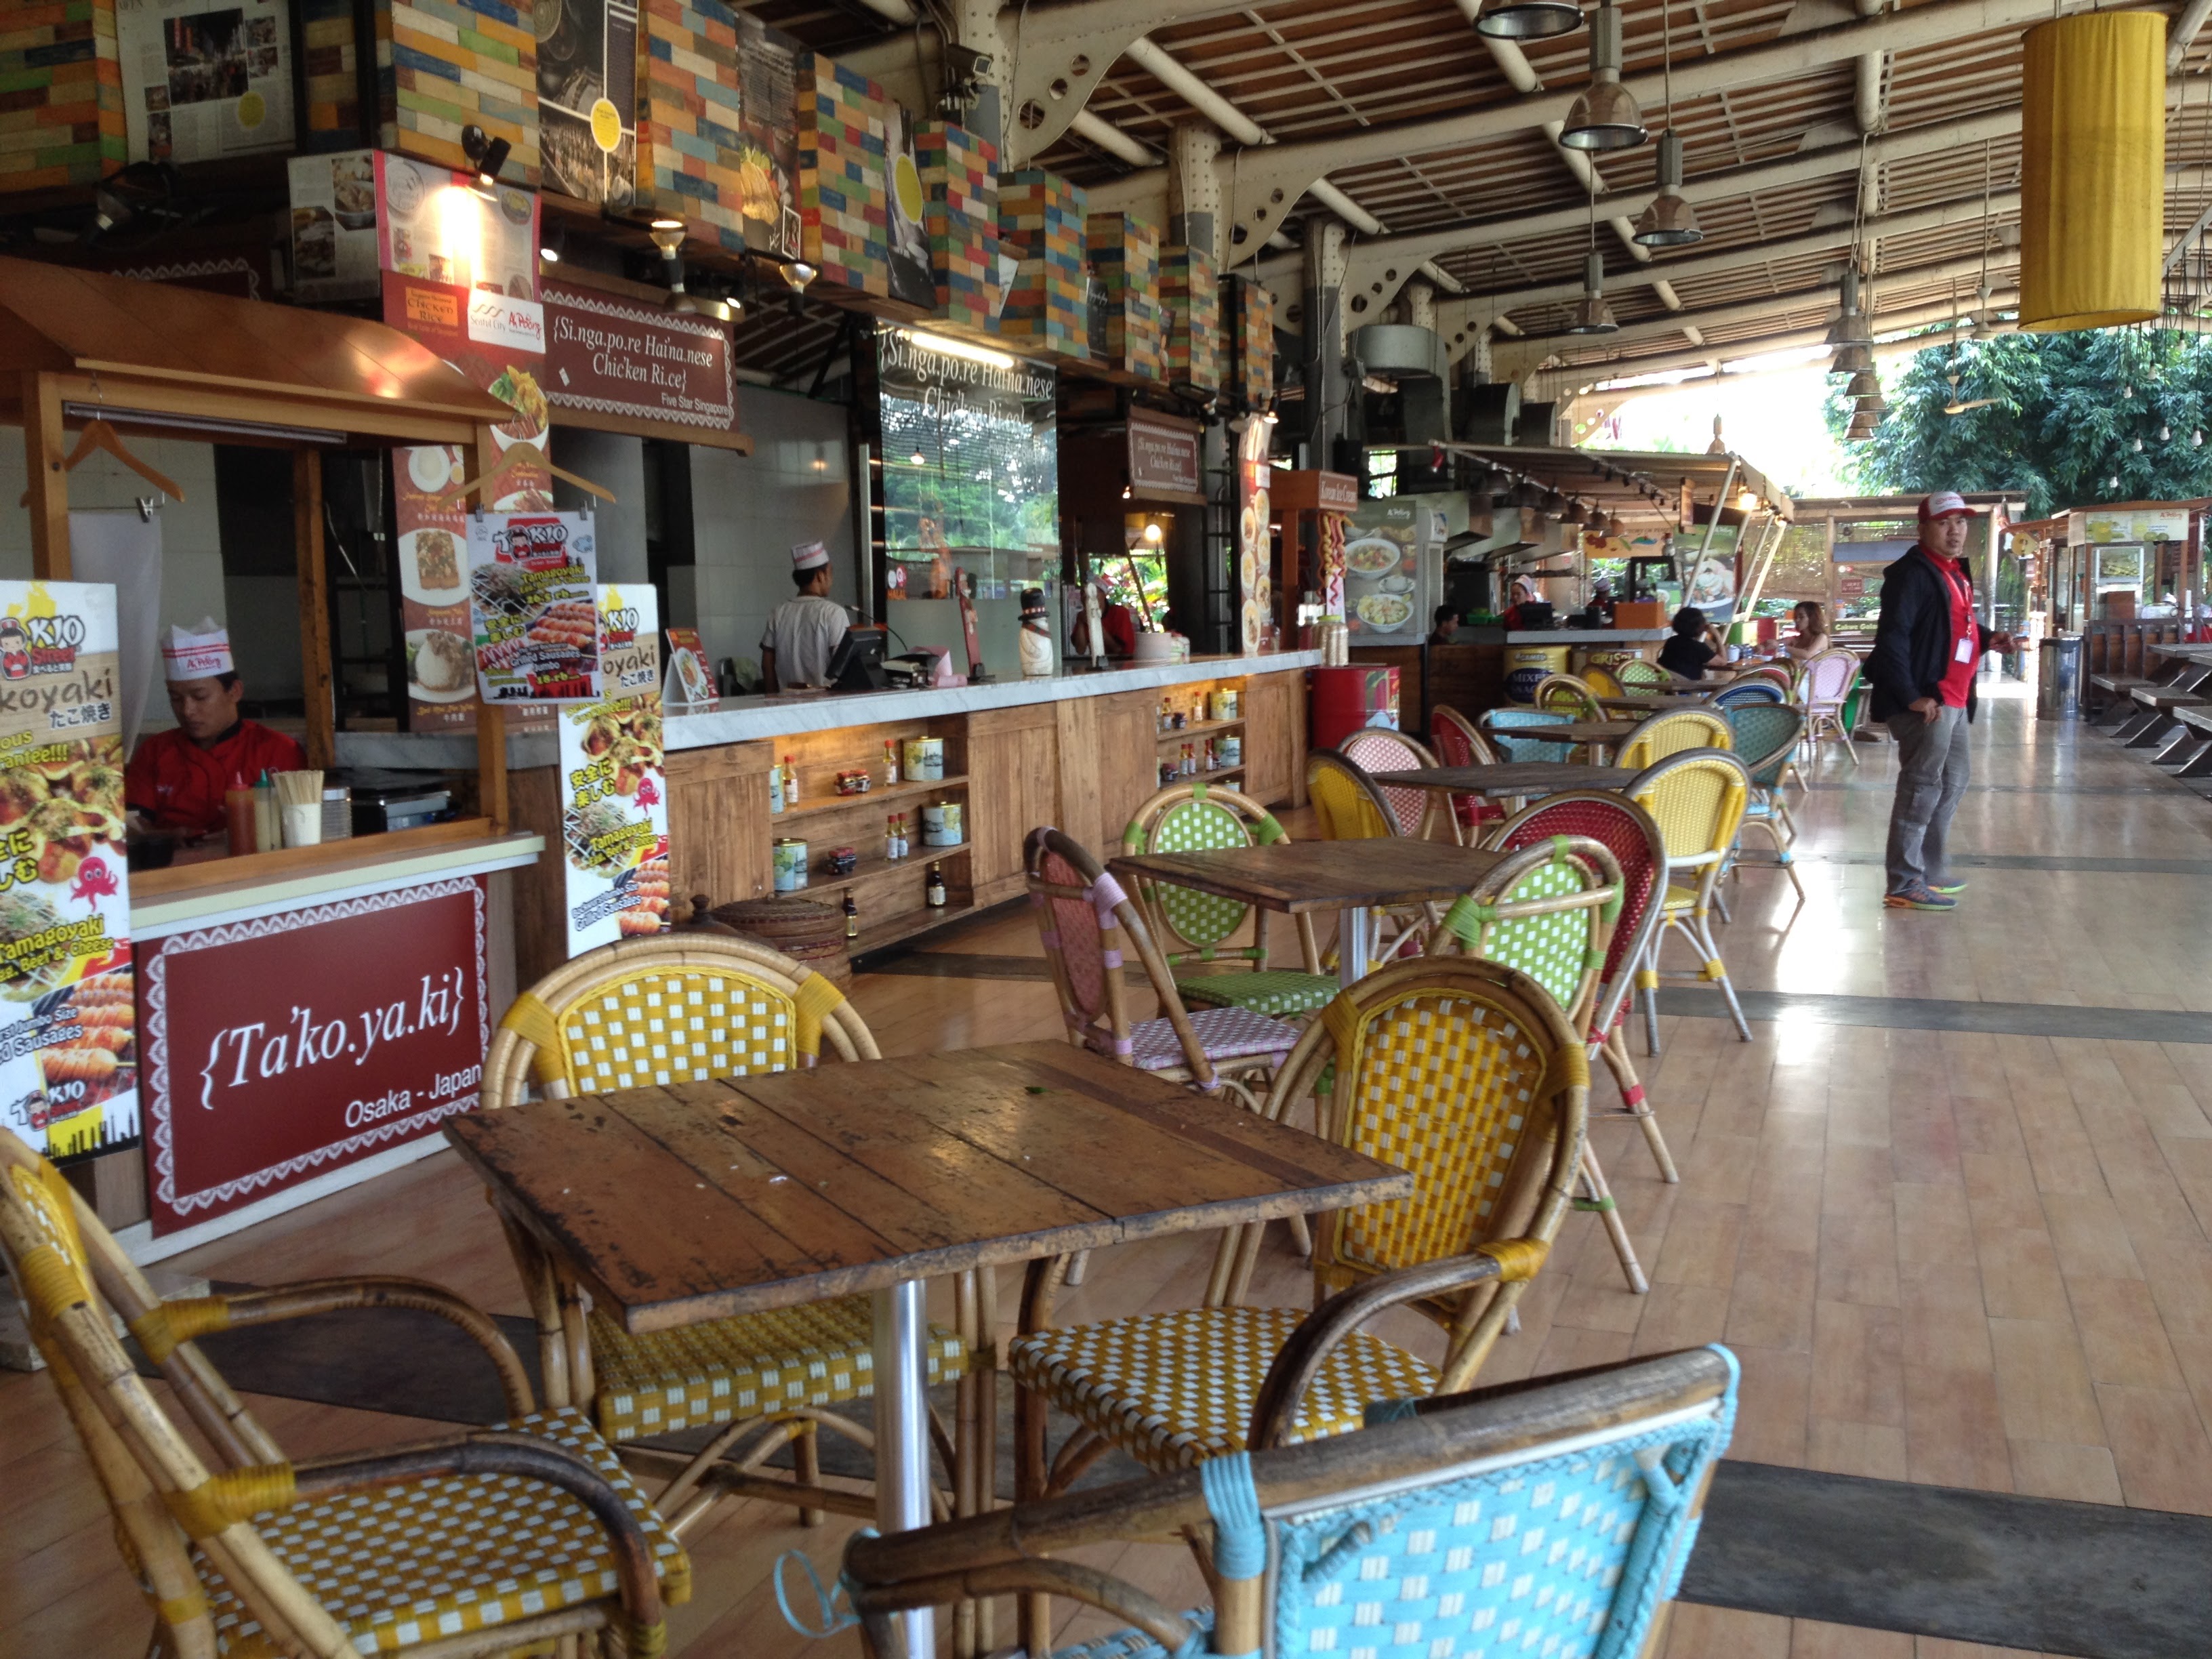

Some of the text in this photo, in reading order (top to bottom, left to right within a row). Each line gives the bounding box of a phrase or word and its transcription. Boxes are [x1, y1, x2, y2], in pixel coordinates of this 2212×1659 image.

[493, 319, 506, 332] City
[49, 701, 112, 731] たこ焼き
[13, 1024, 83, 1057] Sausages
[344, 1091, 412, 1128] Osaka
[428, 1063, 483, 1101] Japan
